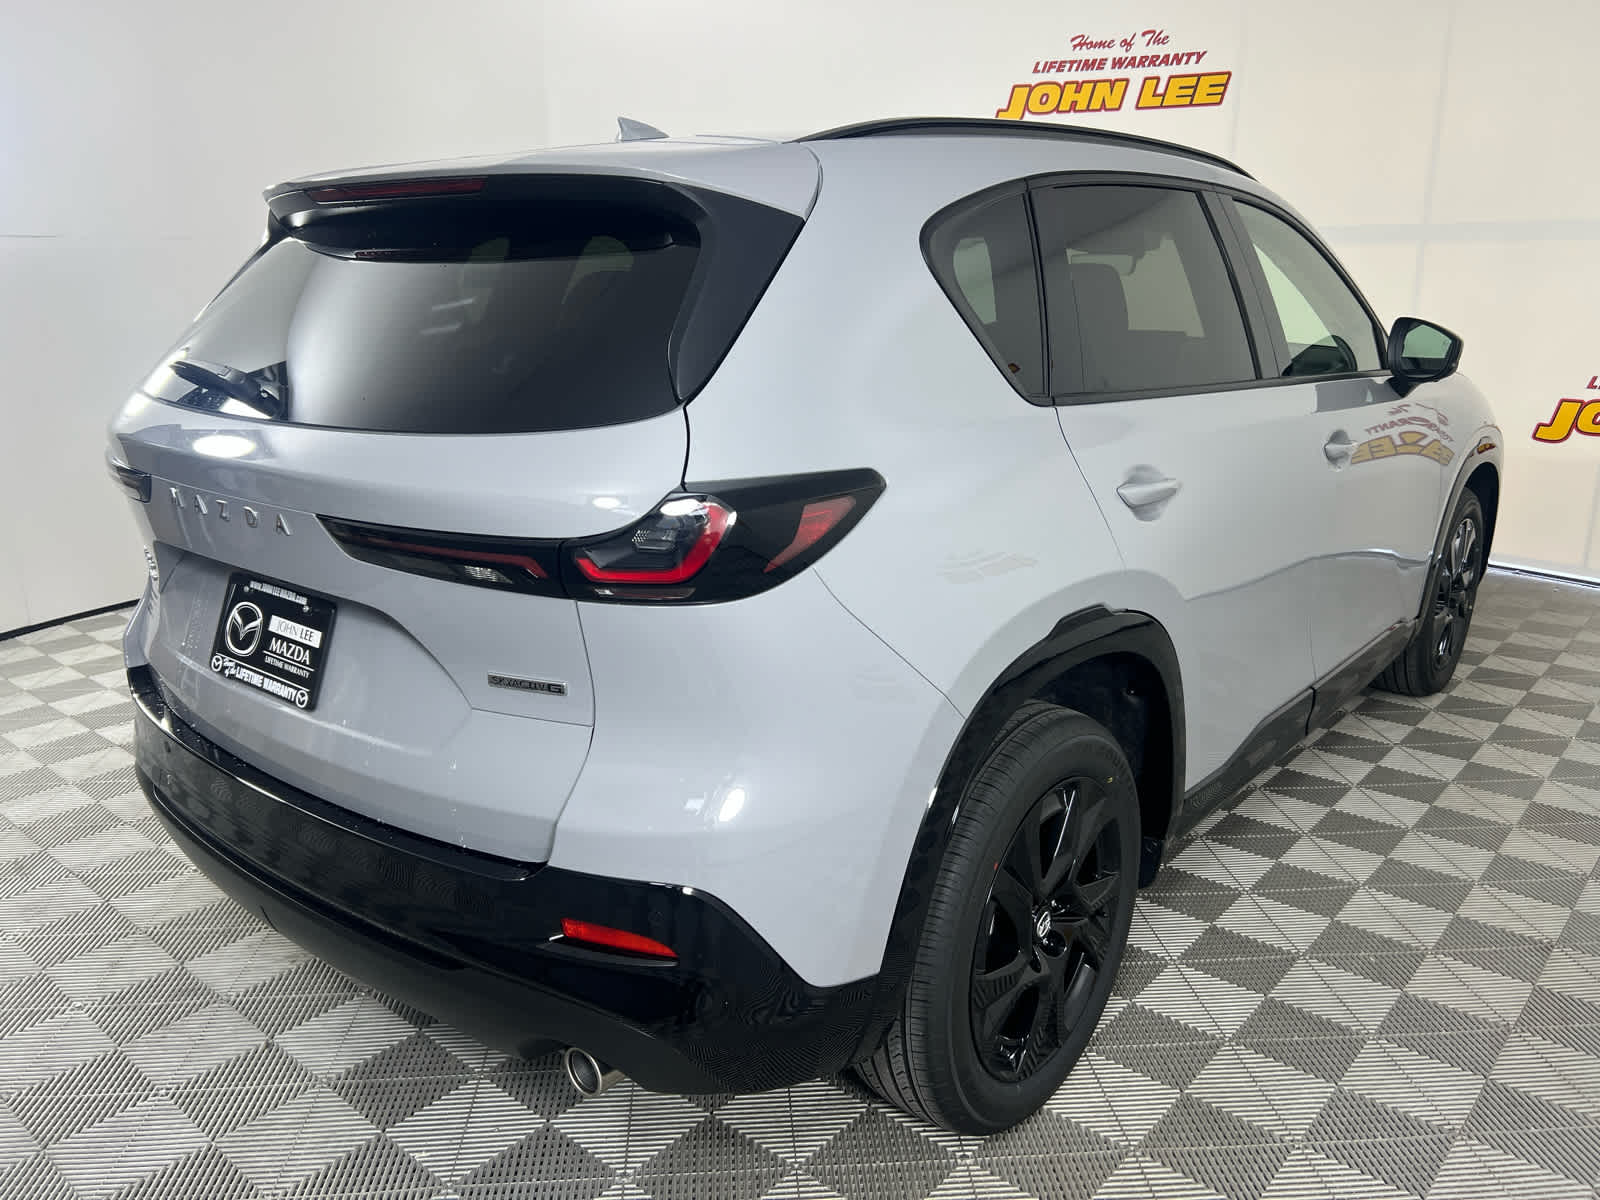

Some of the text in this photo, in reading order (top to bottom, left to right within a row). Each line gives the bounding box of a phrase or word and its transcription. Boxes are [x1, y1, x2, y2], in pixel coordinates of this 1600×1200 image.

[1070, 29, 1170, 53] Home of The
[1032, 50, 1208, 74] LIFETIME WARRANTY
[995, 71, 1232, 120] JOHN LEE
[169, 487, 292, 536] MAZDA
[277, 619, 314, 642] JOHN LEE
[269, 637, 310, 665] MAZDA
[264, 656, 310, 679] LIFETIME WARRANTY
[236, 666, 297, 702] LIFETIME WARRANTY
